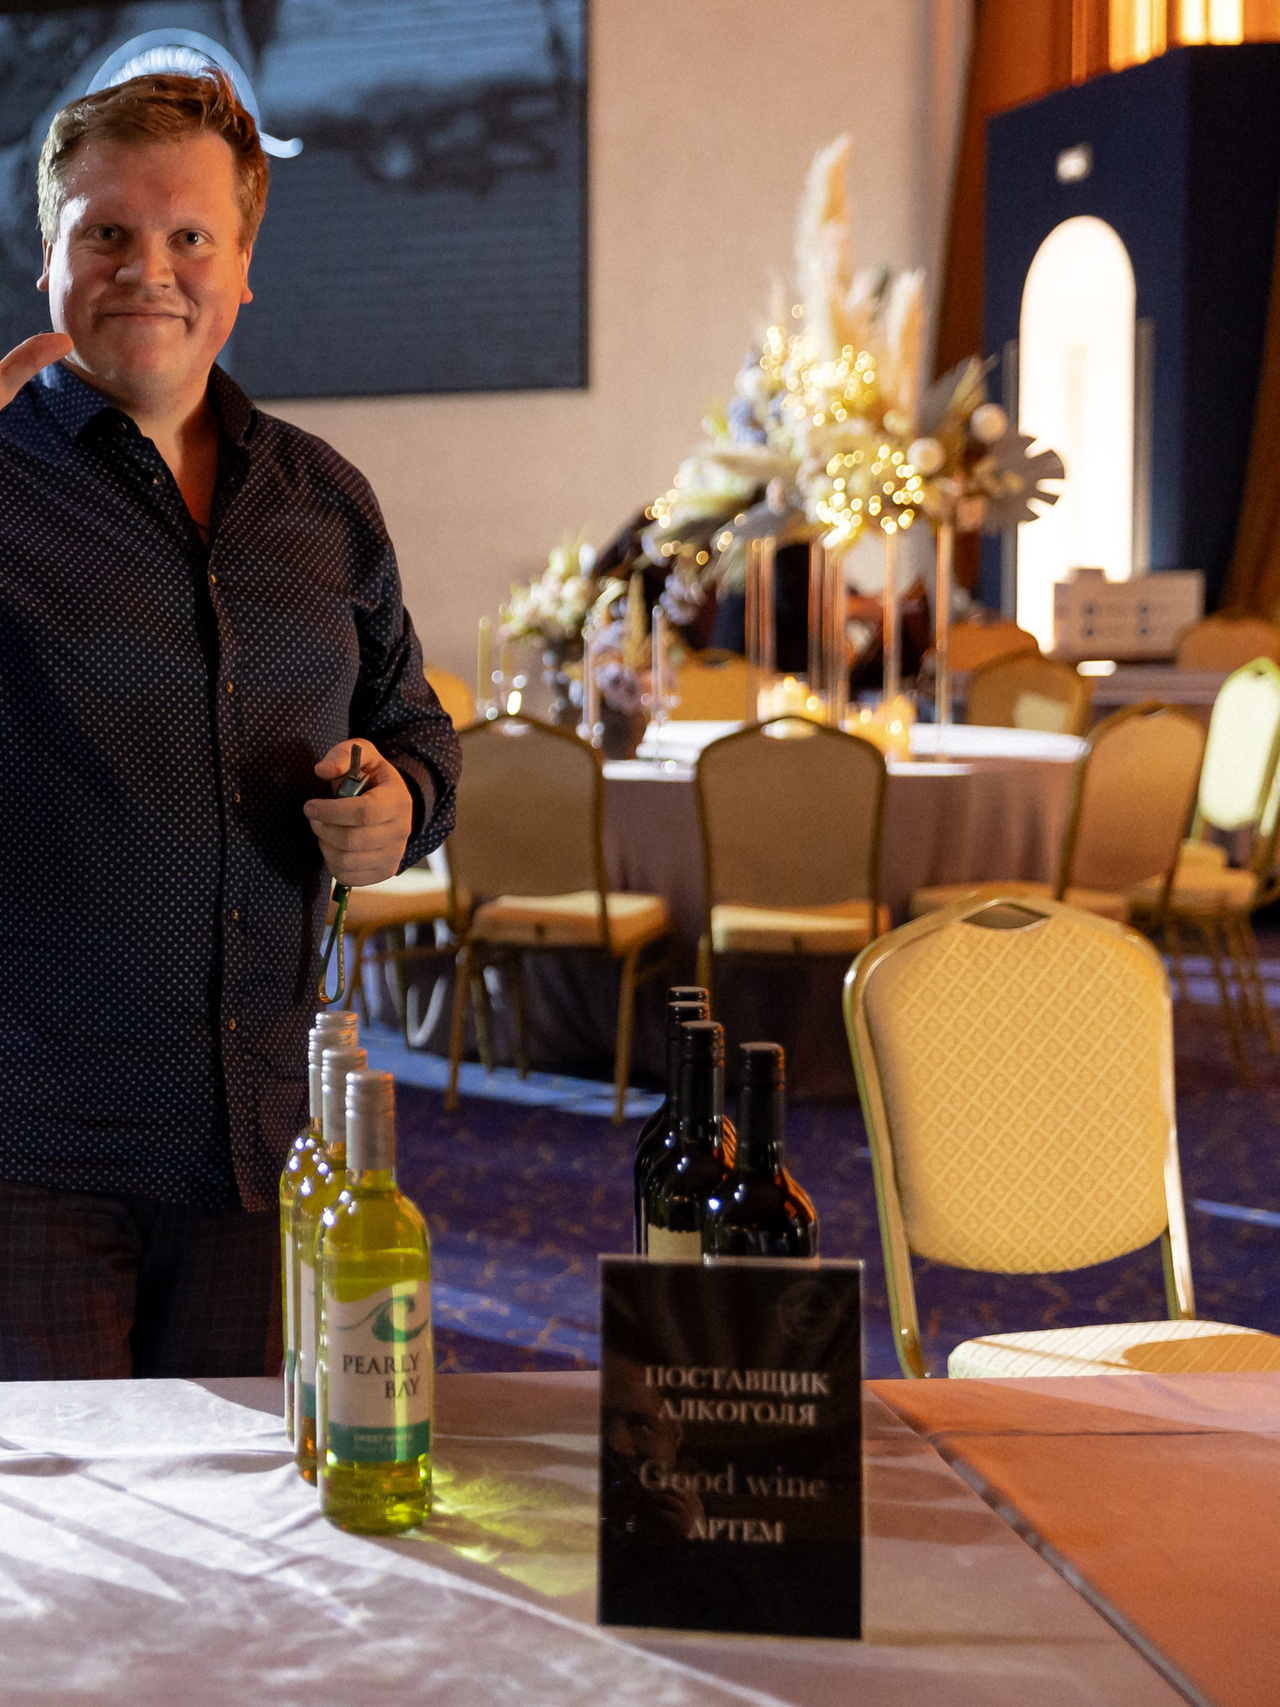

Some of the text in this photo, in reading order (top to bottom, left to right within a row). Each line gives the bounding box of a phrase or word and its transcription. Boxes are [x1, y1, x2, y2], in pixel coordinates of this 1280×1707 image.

[342, 1352, 420, 1374] PEARLY
[385, 1376, 420, 1399] BAY
[644, 1366, 831, 1398] ПОСТАВЩИК
[657, 1399, 817, 1426] АЛКОГОЛЯ
[639, 1459, 826, 1499] Good wine
[686, 1518, 786, 1544] АРТЕМ
